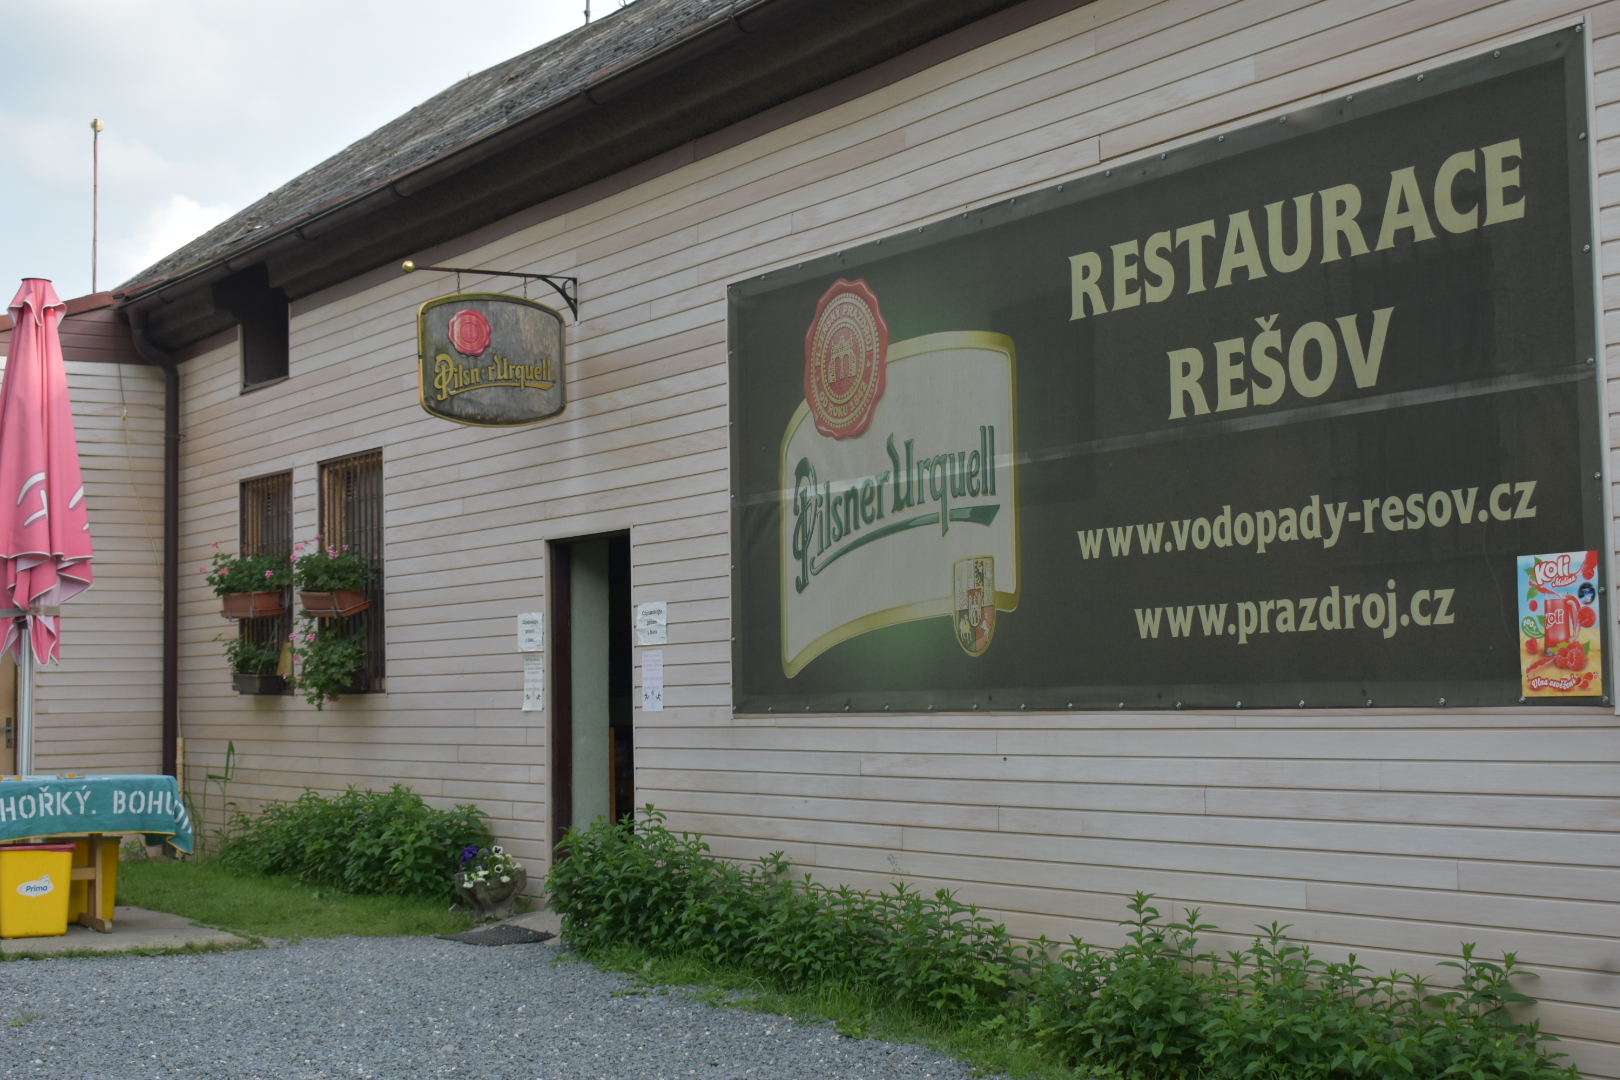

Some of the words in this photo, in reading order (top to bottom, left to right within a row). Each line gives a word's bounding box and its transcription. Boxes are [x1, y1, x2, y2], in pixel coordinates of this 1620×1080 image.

[1068, 138, 1526, 321] RESTAURACE
[842, 305, 873, 352] PRAZDROJ
[434, 353, 494, 401] Pilsnr
[493, 355, 553, 391] Urquell
[1166, 307, 1395, 420] REŠOV
[828, 403, 848, 418] ROKU
[793, 457, 891, 594] Pilsner
[886, 425, 997, 537] Urquell
[1077, 480, 1538, 560] www.vodopady-resov.cz
[1134, 579, 1456, 644] www.prazdroj.cz
[0, 785, 97, 822] HOŘKÝ.
[25, 884, 48, 893] Prima
